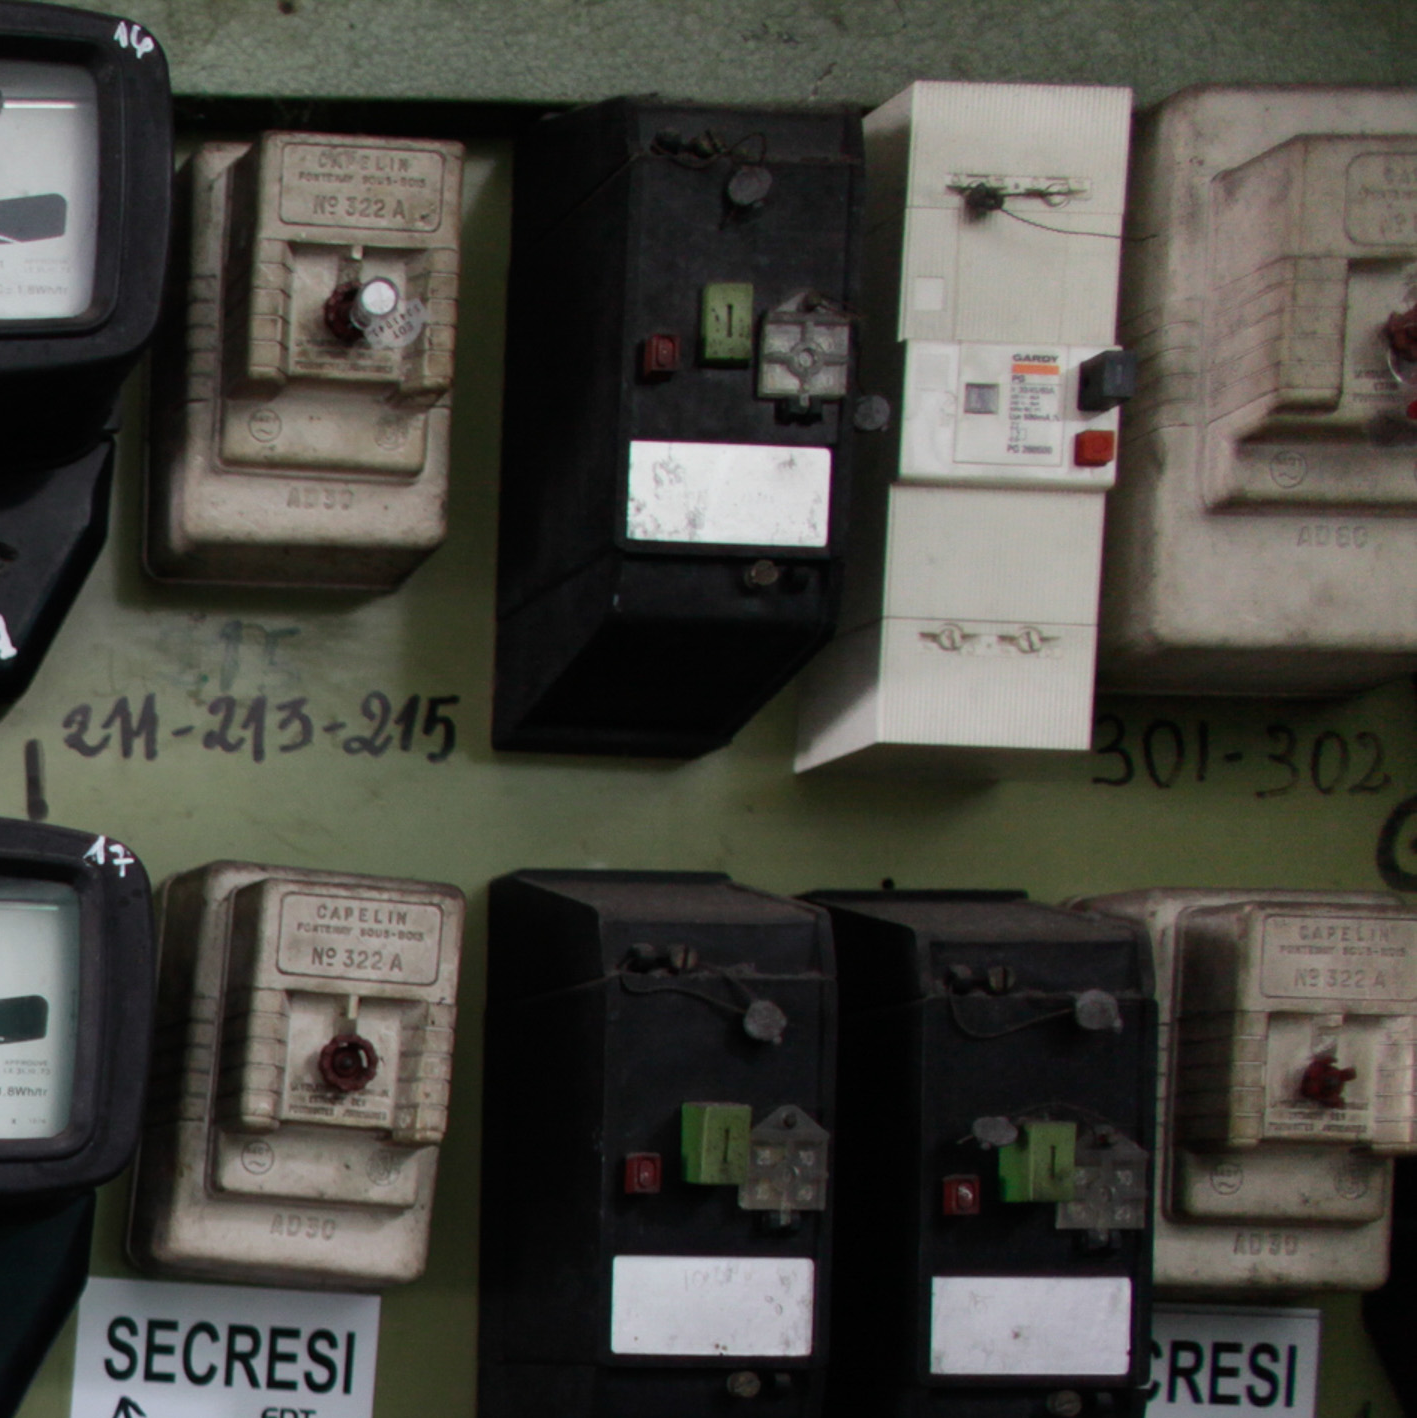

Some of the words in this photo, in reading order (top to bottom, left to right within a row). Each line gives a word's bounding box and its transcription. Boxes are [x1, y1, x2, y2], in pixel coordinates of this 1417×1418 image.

[316, 903, 408, 926] CAPELIN
[343, 949, 383, 971] 322
[104, 1315, 357, 1396] SECRESI
